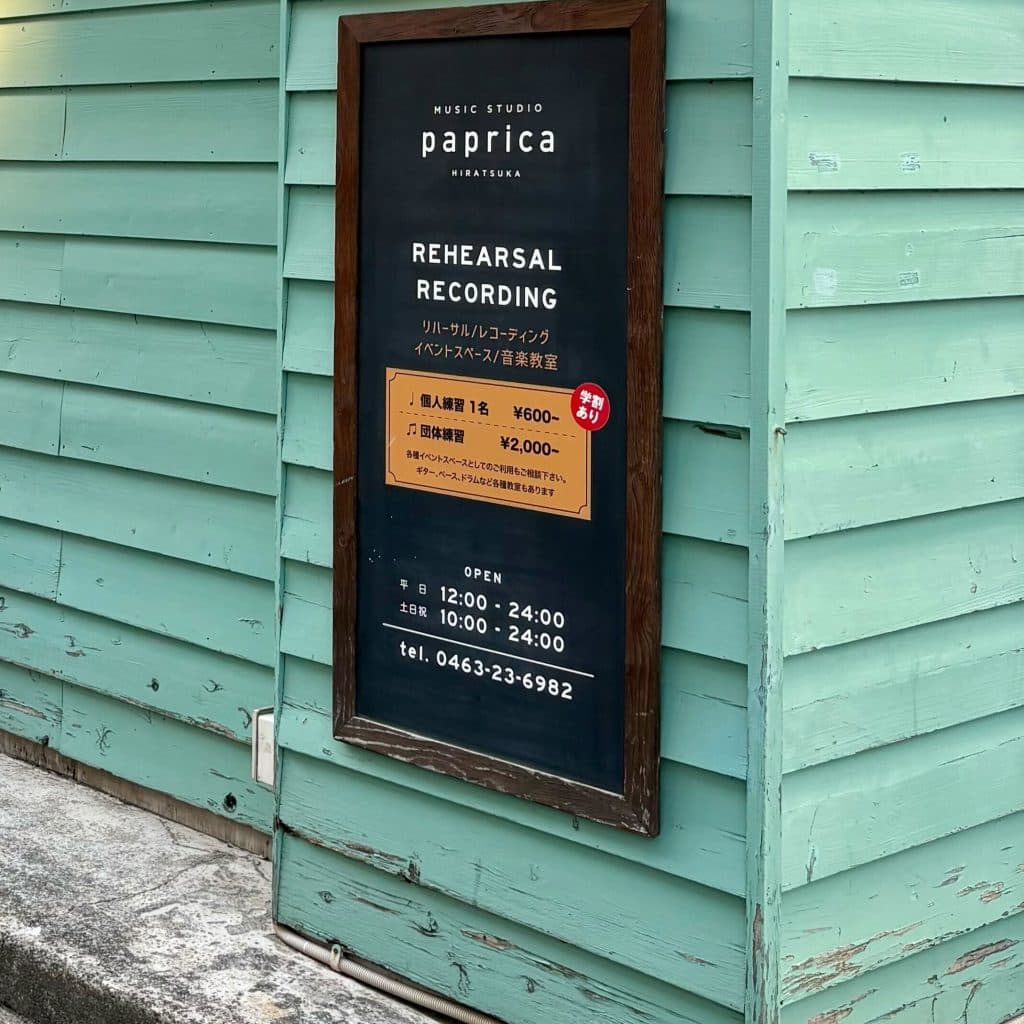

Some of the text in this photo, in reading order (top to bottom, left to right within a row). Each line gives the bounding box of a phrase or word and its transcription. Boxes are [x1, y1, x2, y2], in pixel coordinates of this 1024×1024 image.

[434, 103, 544, 115] MUSIC STUDIO
[422, 125, 555, 158] paprica
[451, 169, 522, 178] HIRATSUKA
[412, 242, 562, 271] REHEARSAL
[416, 279, 558, 309] RECORDING
[420, 393, 465, 413] 個人練習
[579, 389, 605, 411] 学割
[576, 405, 599, 424] あり
[420, 423, 465, 444] 団体練習
[464, 566, 502, 584] OPEN
[440, 586, 487, 611] 12:00
[508, 602, 565, 628] 24:00
[399, 602, 427, 618] 土日祝
[440, 609, 487, 634] 10:00
[508, 625, 565, 652] 24:00
[399, 640, 573, 700] tel. 0463-23-6982
